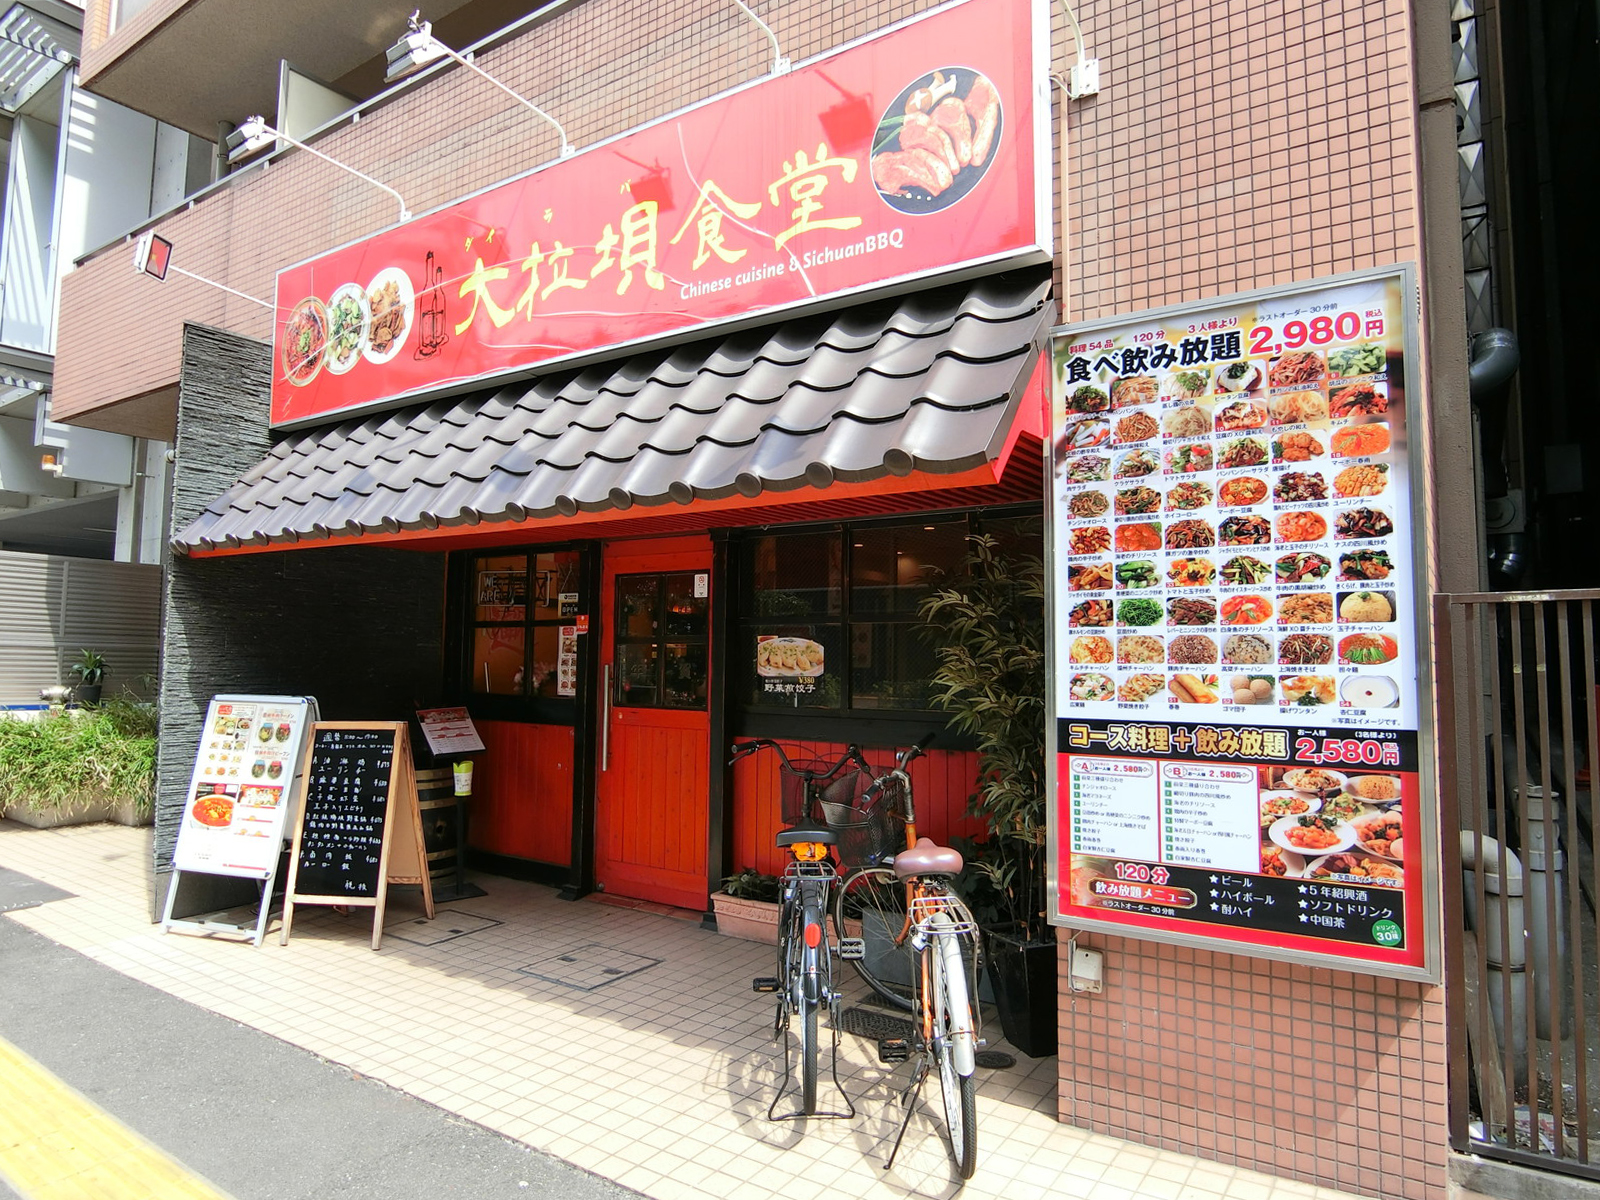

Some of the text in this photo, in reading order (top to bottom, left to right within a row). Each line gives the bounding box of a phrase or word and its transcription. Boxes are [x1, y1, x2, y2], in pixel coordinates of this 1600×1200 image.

[680, 228, 904, 300] Chinese cuisine & SichuanBBQ
[1067, 331, 1241, 385] 食べ飲み放題
[1331, 418, 1349, 426] キムチ
[1164, 474, 1197, 482] トマトサラダ
[1217, 507, 1253, 515] マーボー豆腐
[798, 676, 815, 684] ¥380
[1081, 762, 1089, 770] A
[1173, 767, 1181, 776] B
[1114, 862, 1170, 885] 120分
[1221, 876, 1253, 888] ビール
[1095, 881, 1191, 903] 飲み放題メニュー
[1221, 890, 1275, 905] ハイボール
[1309, 885, 1368, 902] 5年紹興酒
[1221, 904, 1253, 918] 酎ハイ
[1310, 899, 1393, 919] ソフトドリンク
[1309, 914, 1346, 929] 中国茶
